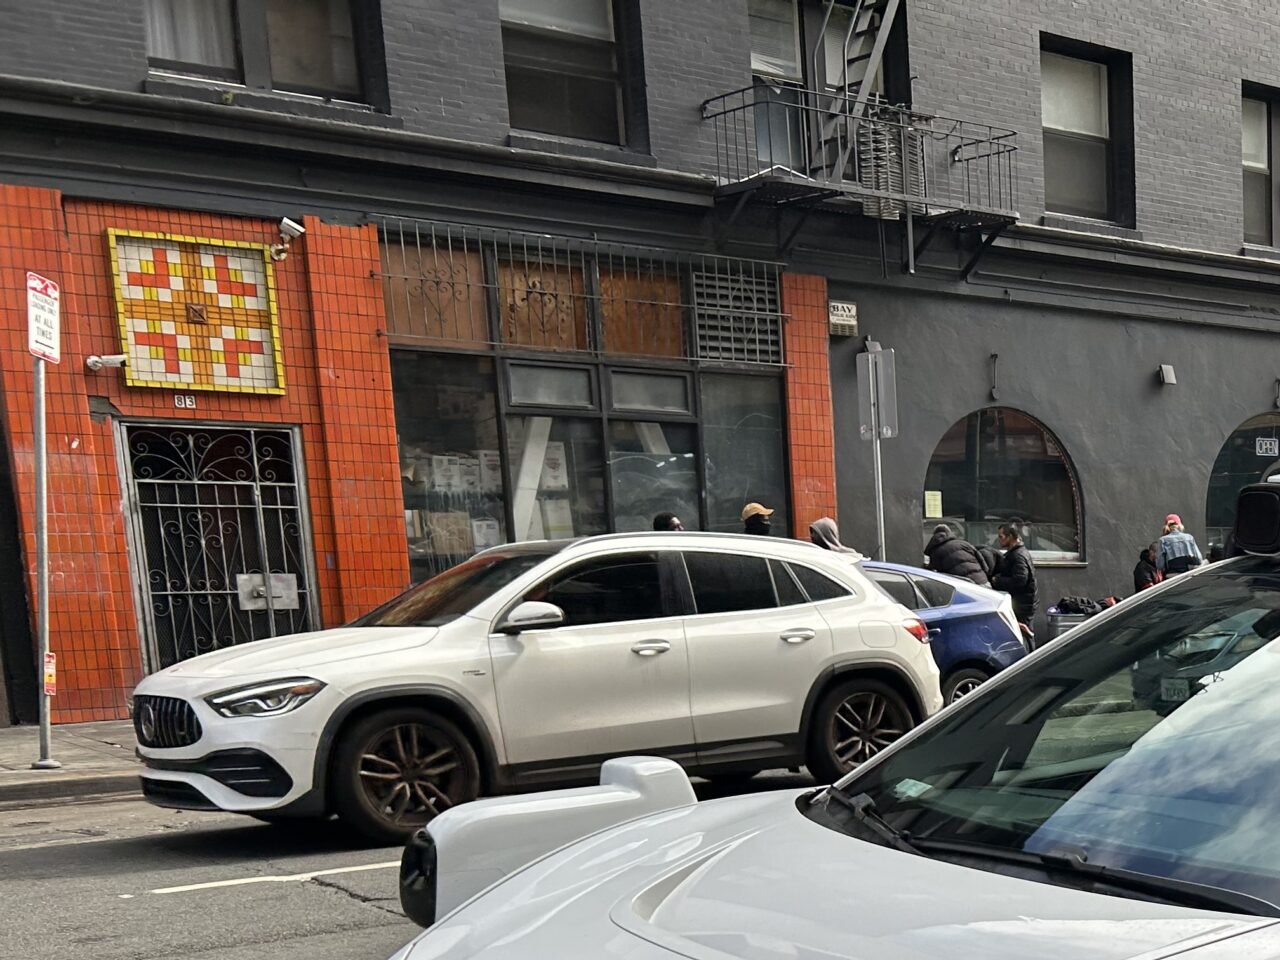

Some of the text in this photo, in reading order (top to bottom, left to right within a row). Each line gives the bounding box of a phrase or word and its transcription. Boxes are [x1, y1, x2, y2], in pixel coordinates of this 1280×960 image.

[833, 305, 852, 313] BAY
[35, 314, 54, 330] AT ALL
[36, 326, 52, 341] TIMES
[176, 396, 194, 406] 83
[1259, 440, 1278, 454] OPEN
